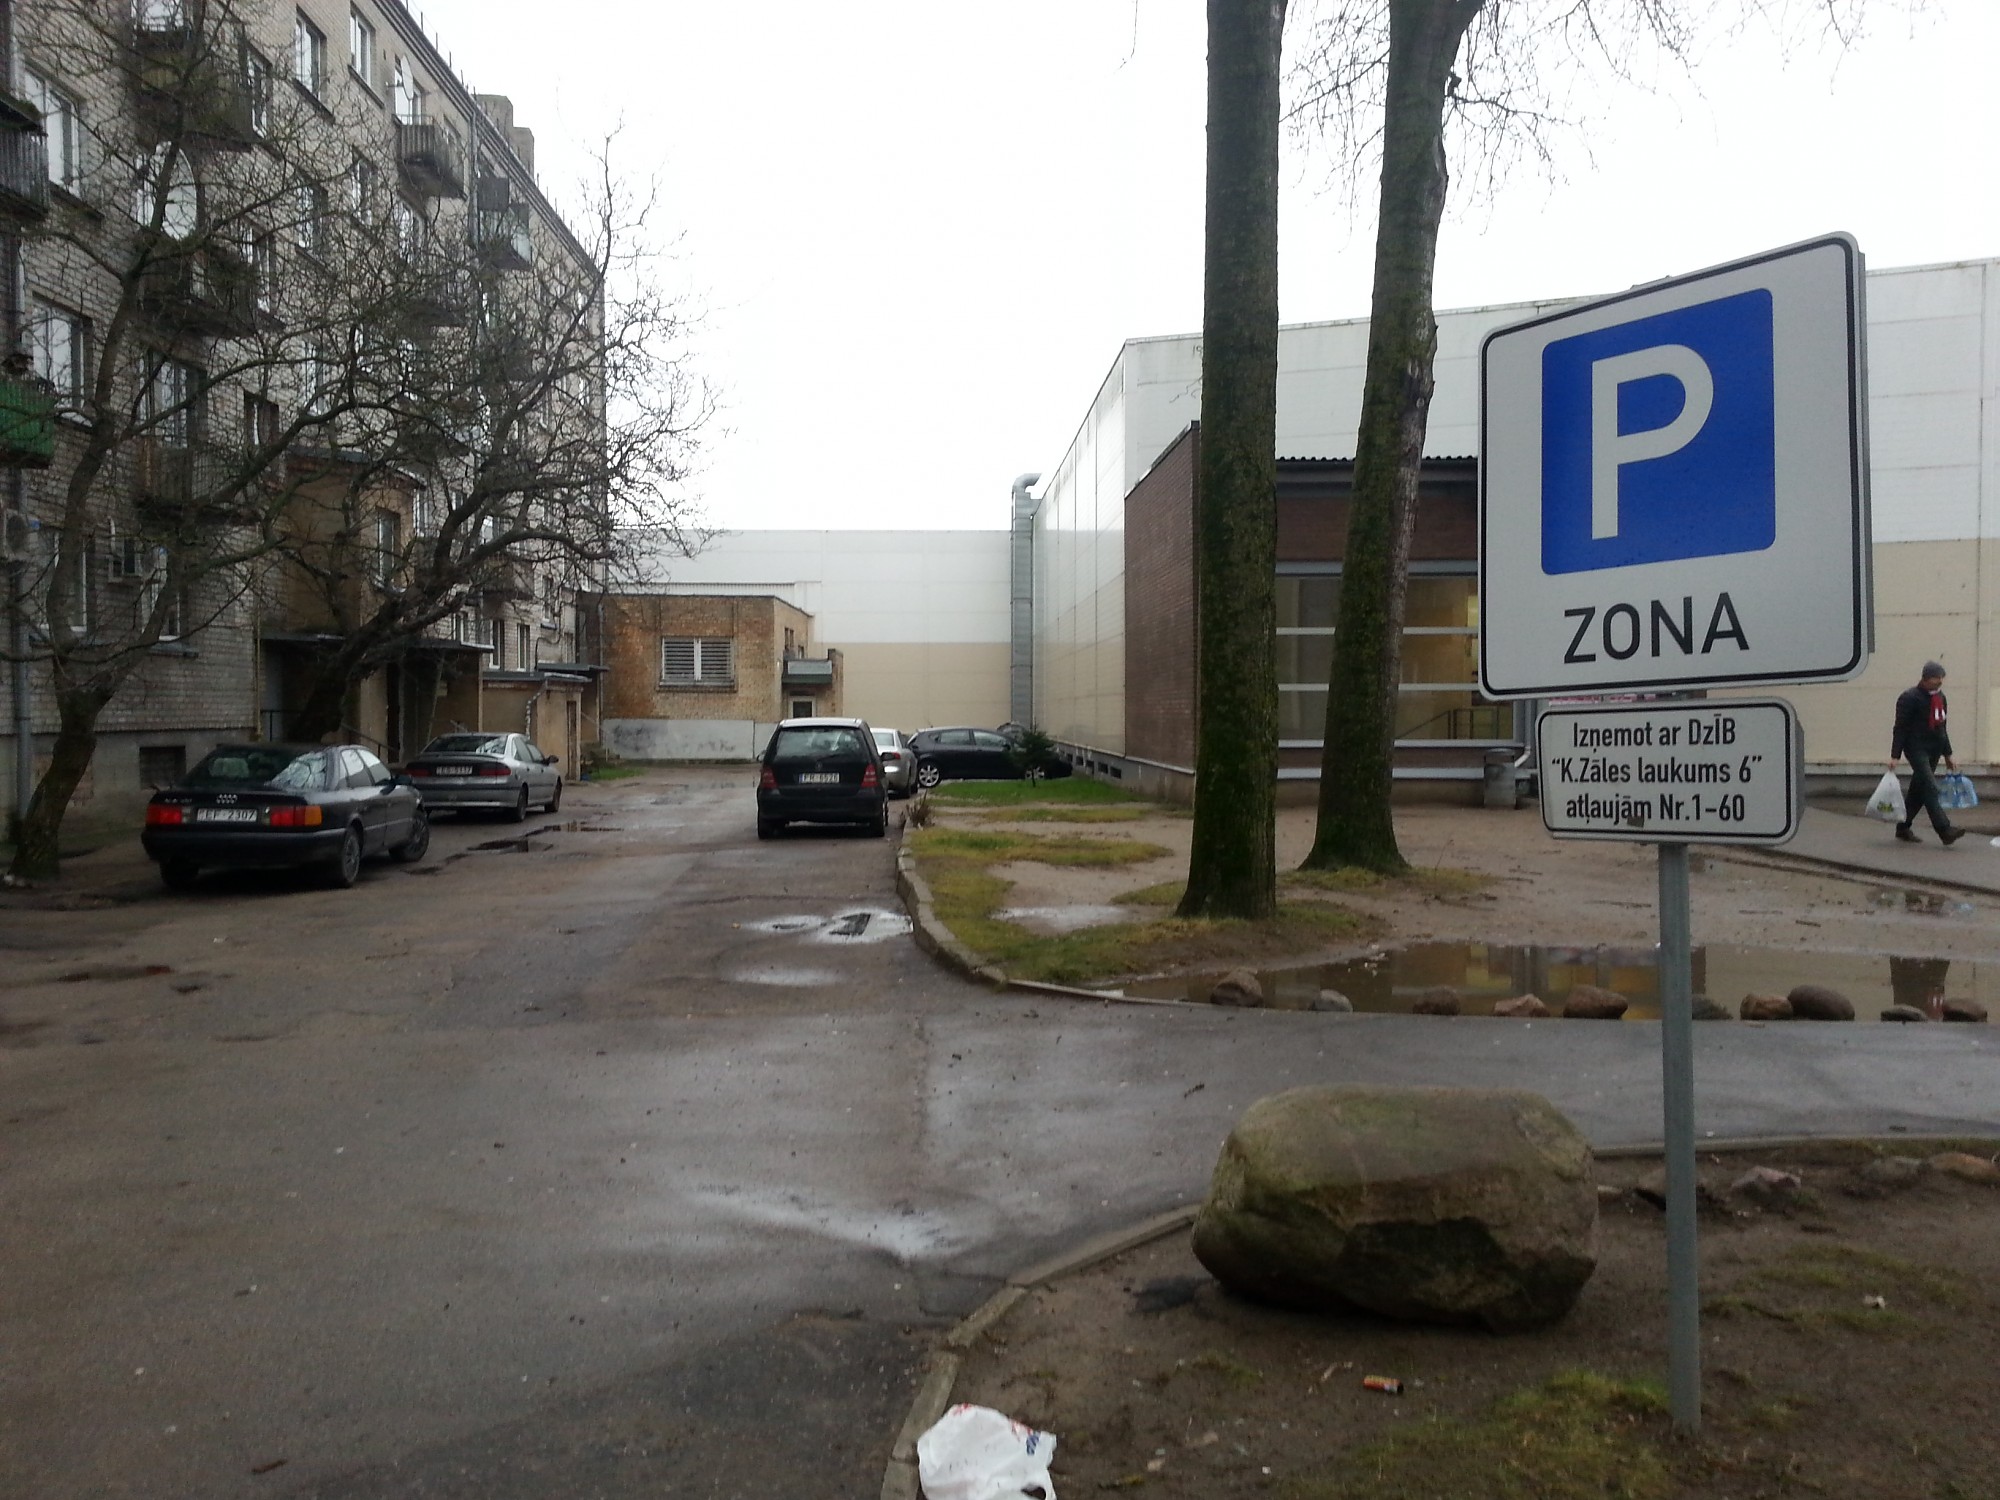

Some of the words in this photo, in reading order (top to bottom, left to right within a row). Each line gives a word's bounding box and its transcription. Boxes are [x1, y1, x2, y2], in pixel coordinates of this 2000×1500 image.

[1592, 344, 1714, 540] P
[1564, 592, 1750, 664] ZONA
[1573, 721, 1653, 753] Izņemot
[1658, 725, 1682, 746] ar
[1688, 713, 1736, 746] DzĪB
[1637, 756, 1731, 784] laukums
[1565, 792, 1652, 825] atļaujām
